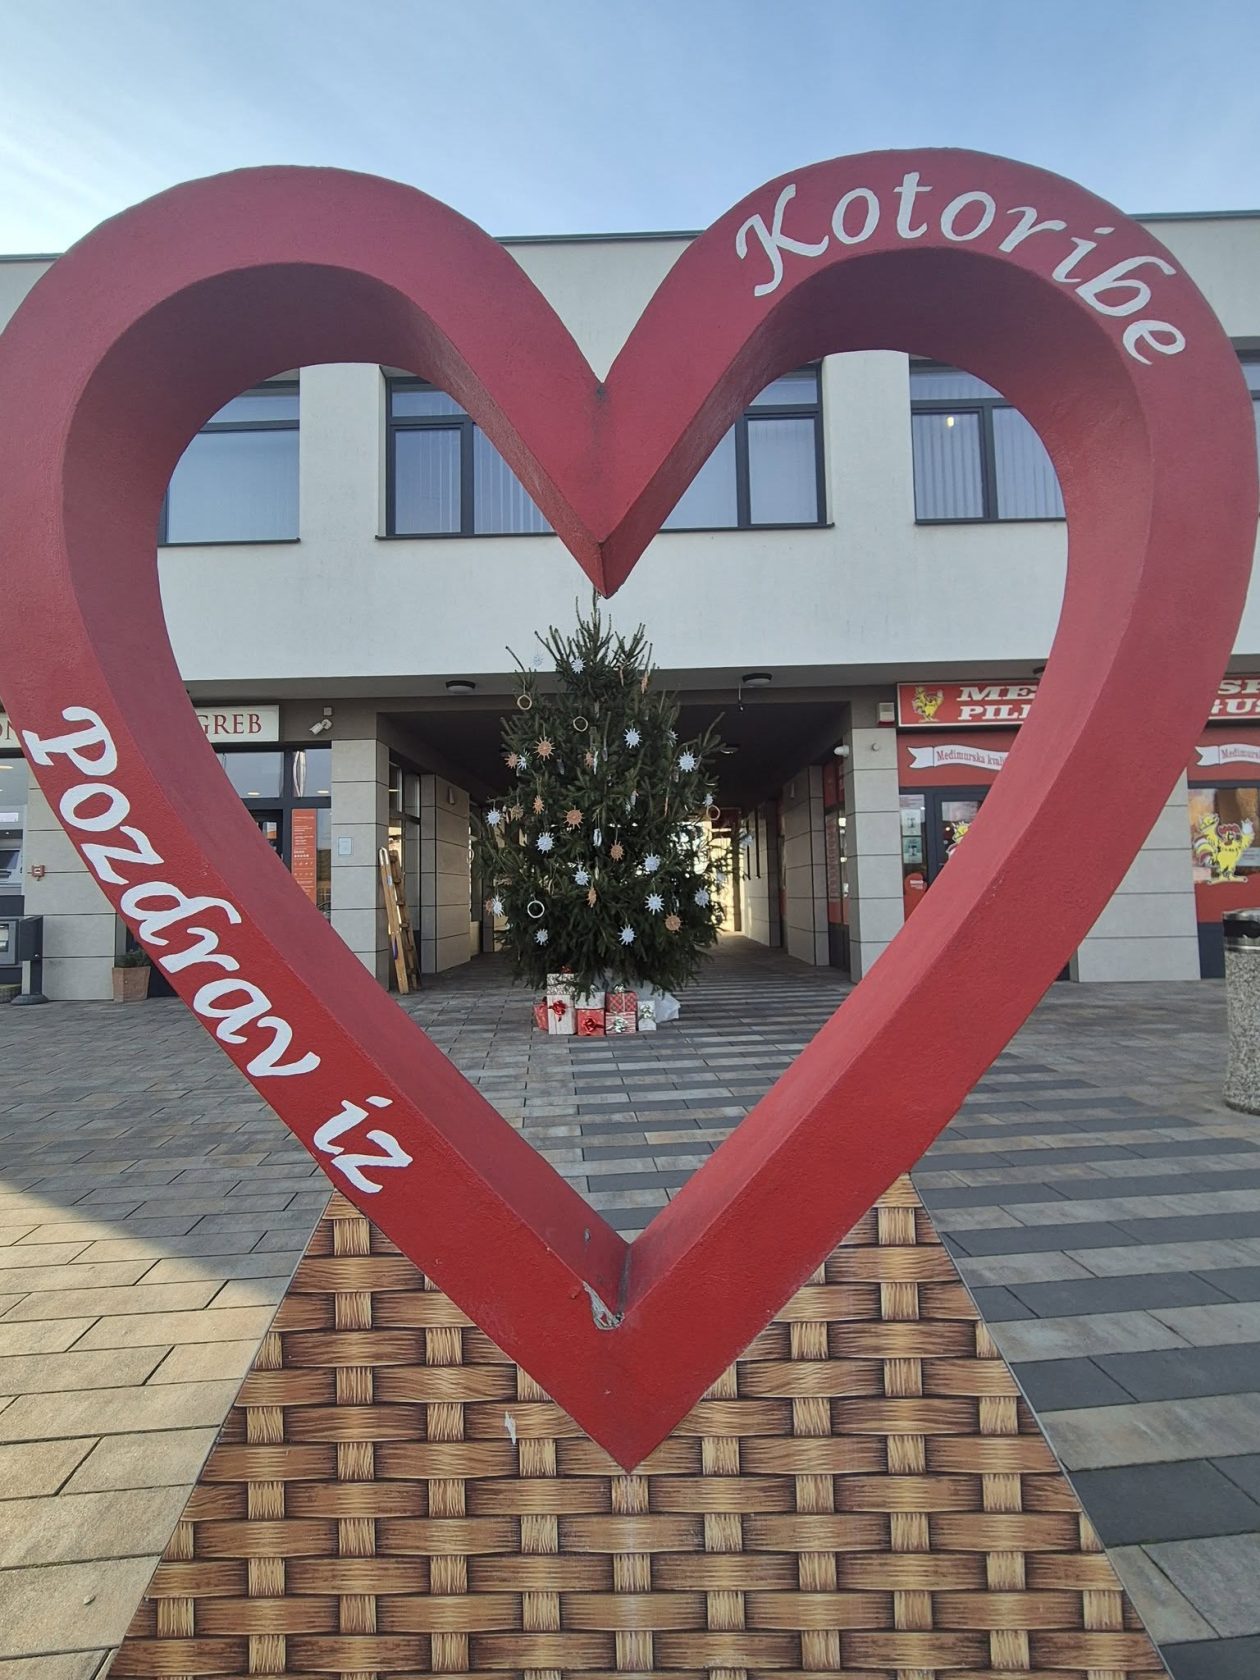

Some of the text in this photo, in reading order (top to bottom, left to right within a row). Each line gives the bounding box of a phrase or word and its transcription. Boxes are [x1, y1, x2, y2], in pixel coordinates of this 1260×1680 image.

[735, 171, 1187, 366] Kotoribe
[21, 705, 414, 1195] Pozdrav iz
